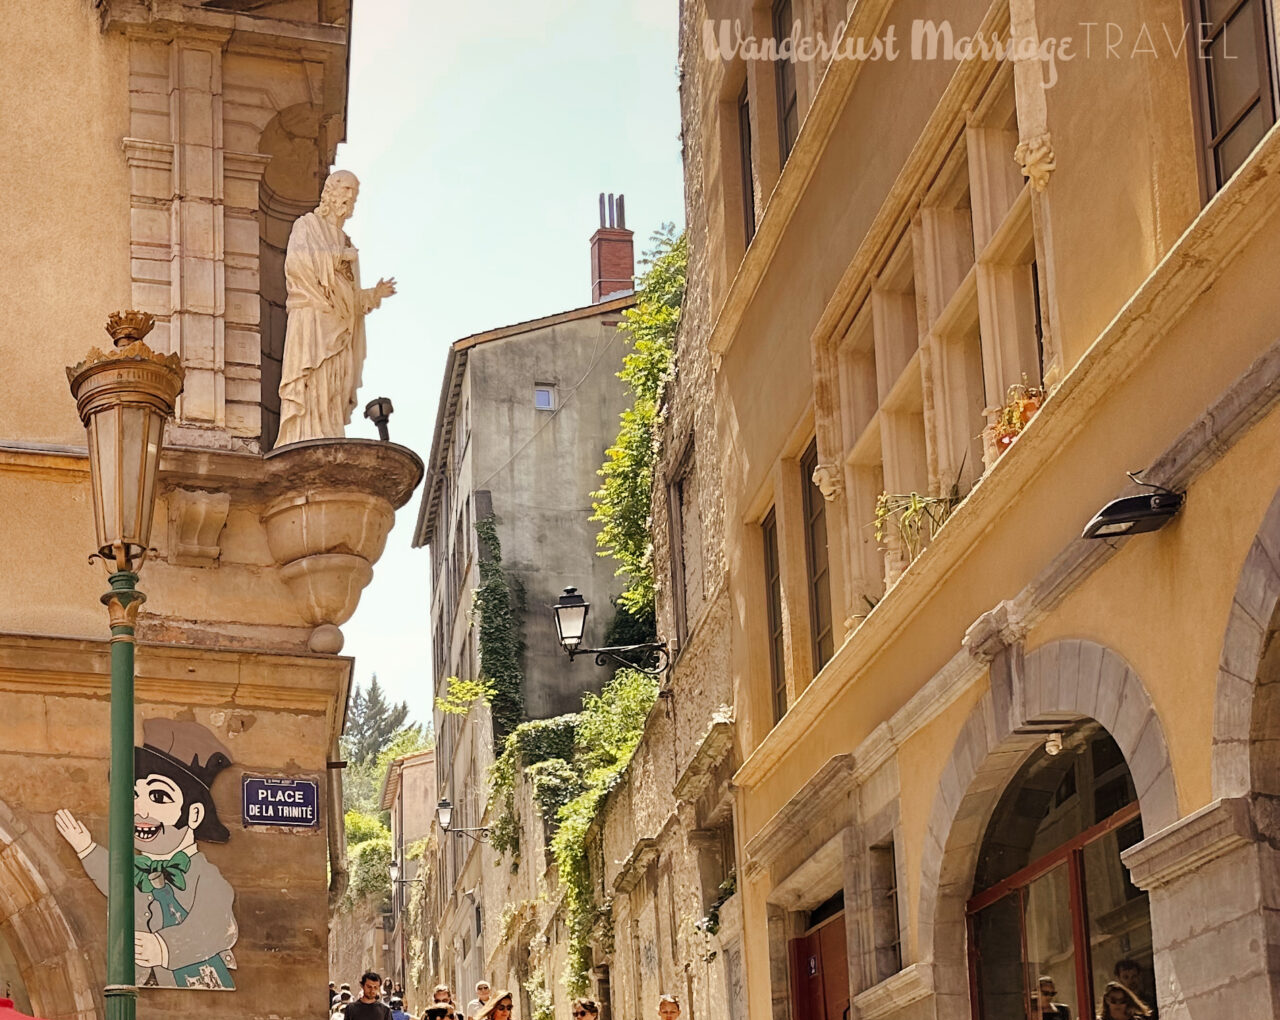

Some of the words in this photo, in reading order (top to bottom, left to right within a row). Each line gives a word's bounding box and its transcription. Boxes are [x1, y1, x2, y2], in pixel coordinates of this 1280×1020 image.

[258, 789, 304, 803] PLACE
[249, 804, 260, 816] DE
[262, 805, 274, 816] LA
[278, 805, 313, 818] TRINITÉ
